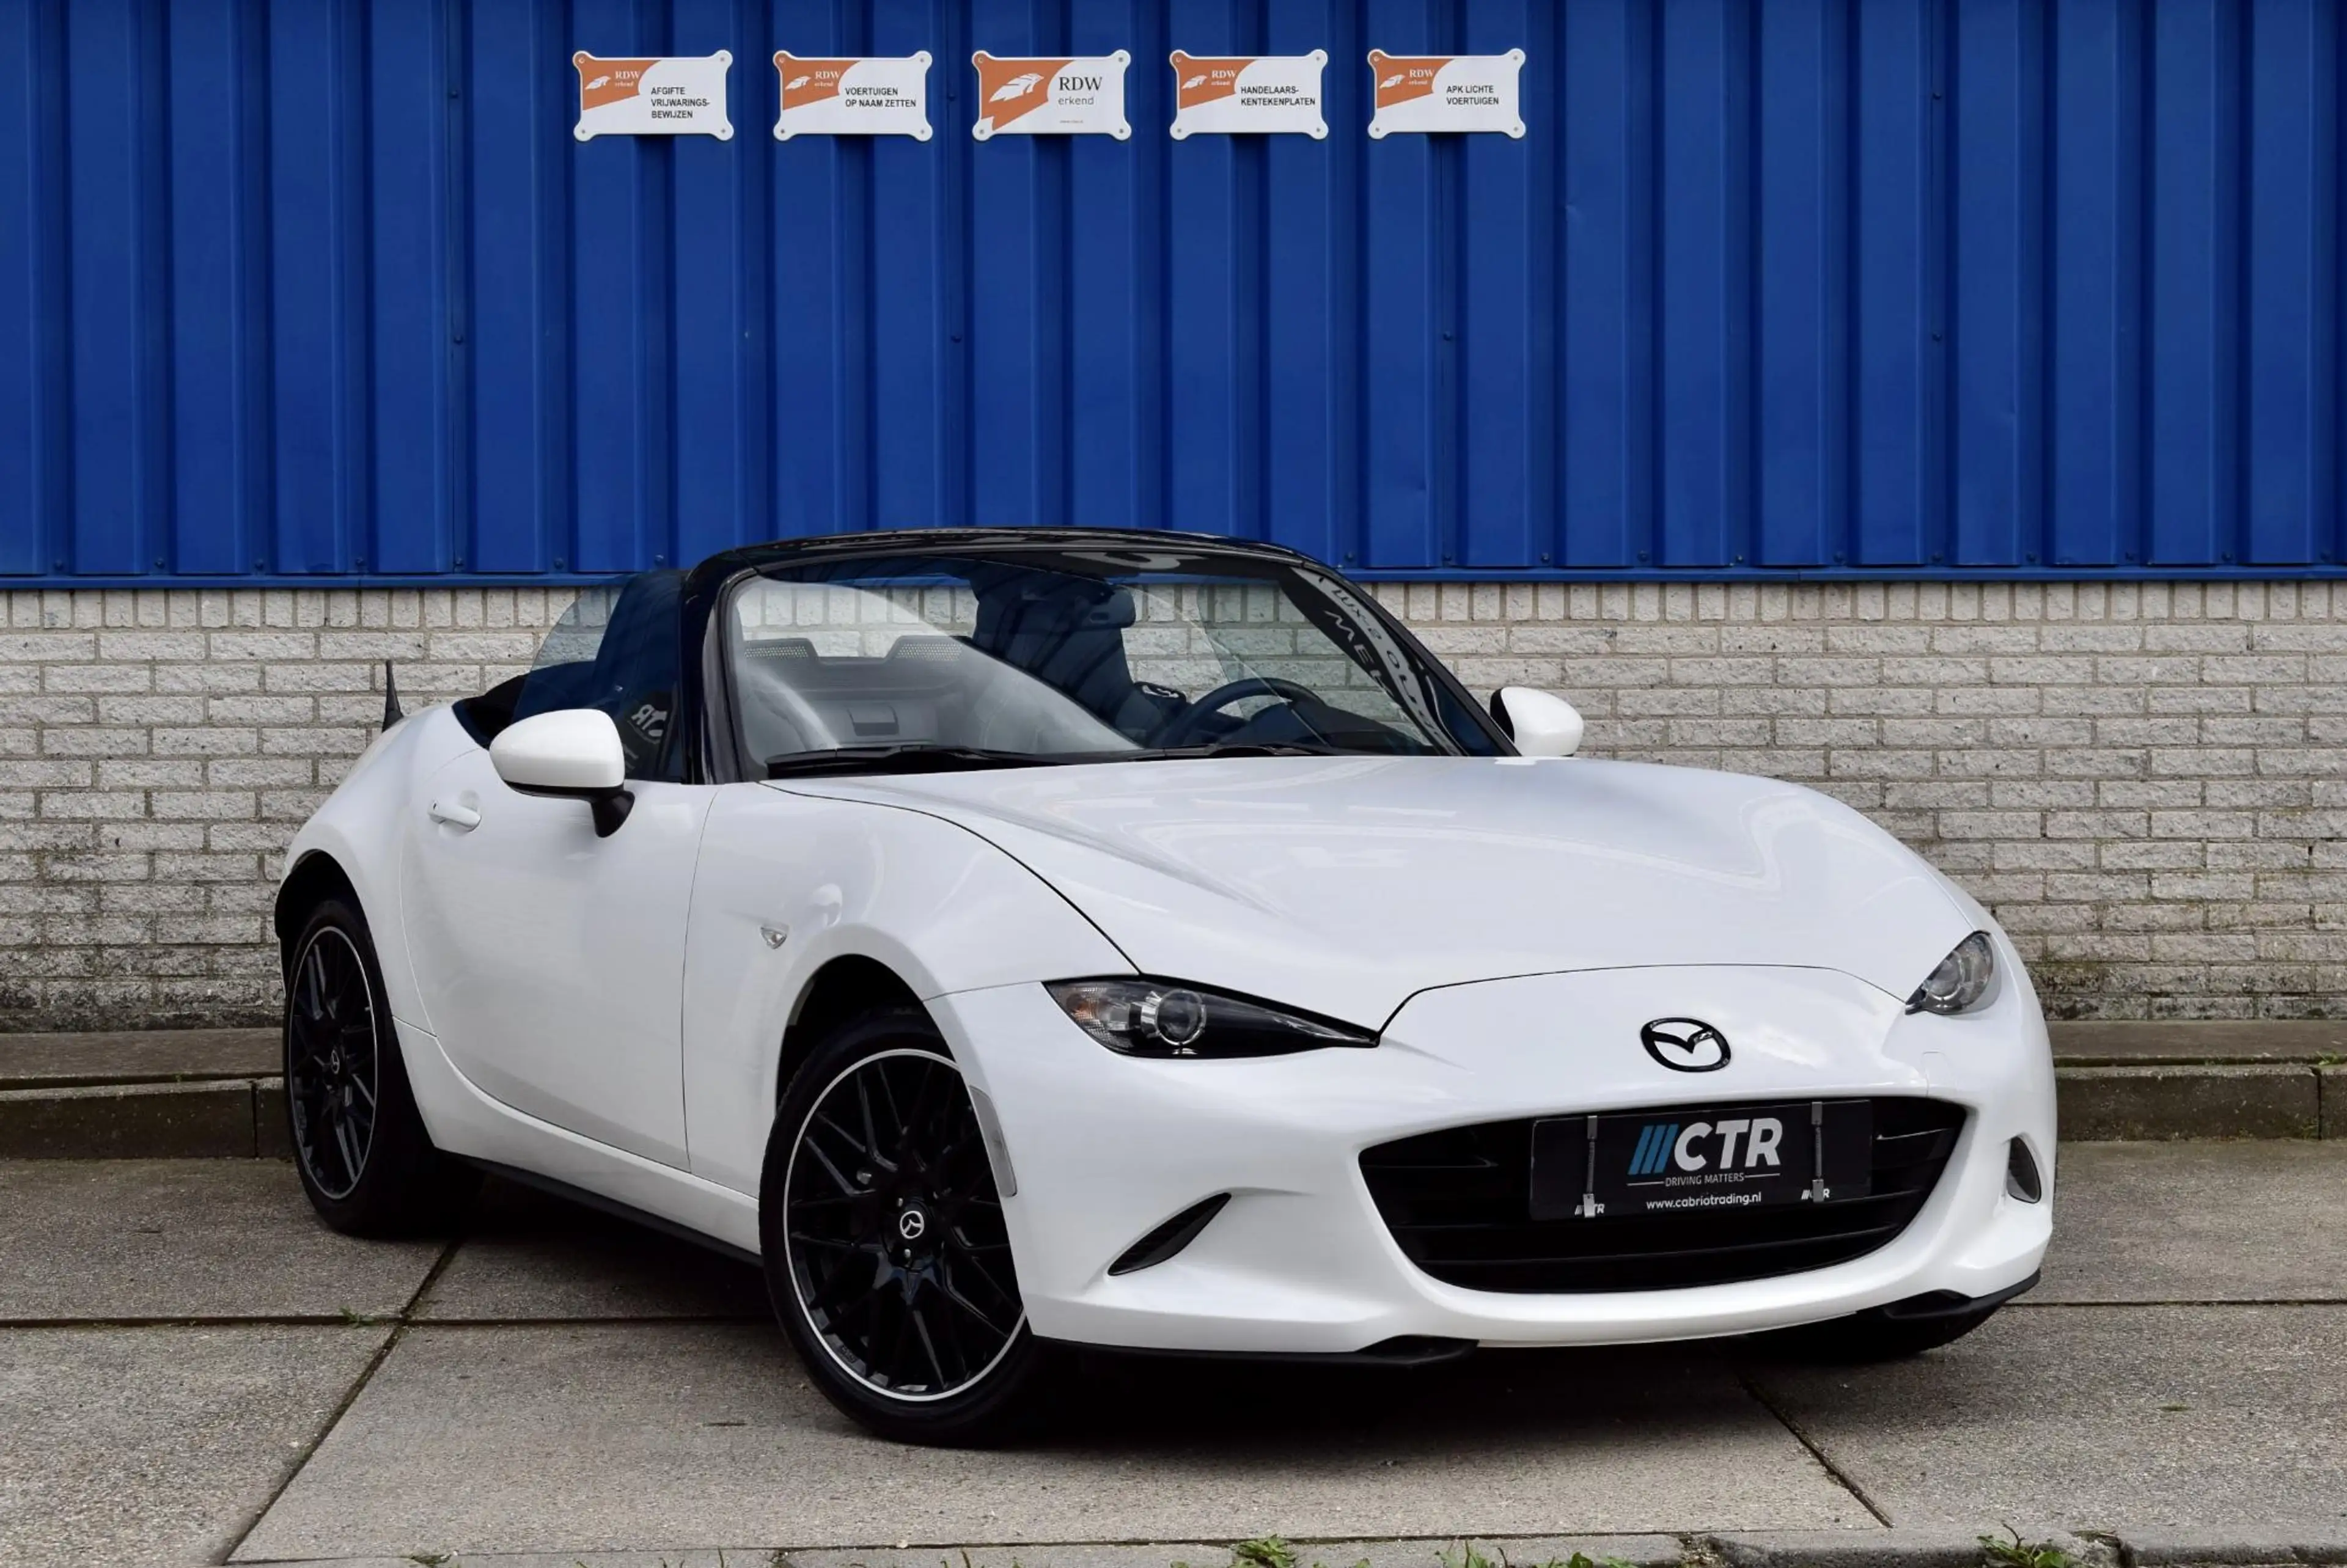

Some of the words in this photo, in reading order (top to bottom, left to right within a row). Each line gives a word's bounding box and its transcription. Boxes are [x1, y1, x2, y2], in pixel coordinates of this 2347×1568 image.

[615, 70, 641, 79] RDW
[815, 70, 841, 79] RDW
[1211, 69, 1237, 78] RDW
[1409, 68, 1435, 78] RDW
[1059, 76, 1103, 91] RDW
[1465, 85, 1494, 93] LICHTE
[651, 98, 710, 107] VRIJWARINGS-
[1058, 96, 1095, 105] erkend
[1241, 97, 1316, 106] KENTEKENPLATEN
[652, 110, 693, 119] BEWIJZEN
[1674, 1118, 1783, 1171] CTR
[1665, 1174, 1702, 1187] DRIVING
[1704, 1173, 1745, 1184] MATTERS
[1646, 1192, 1762, 1210] www.cabriotrading.nl
